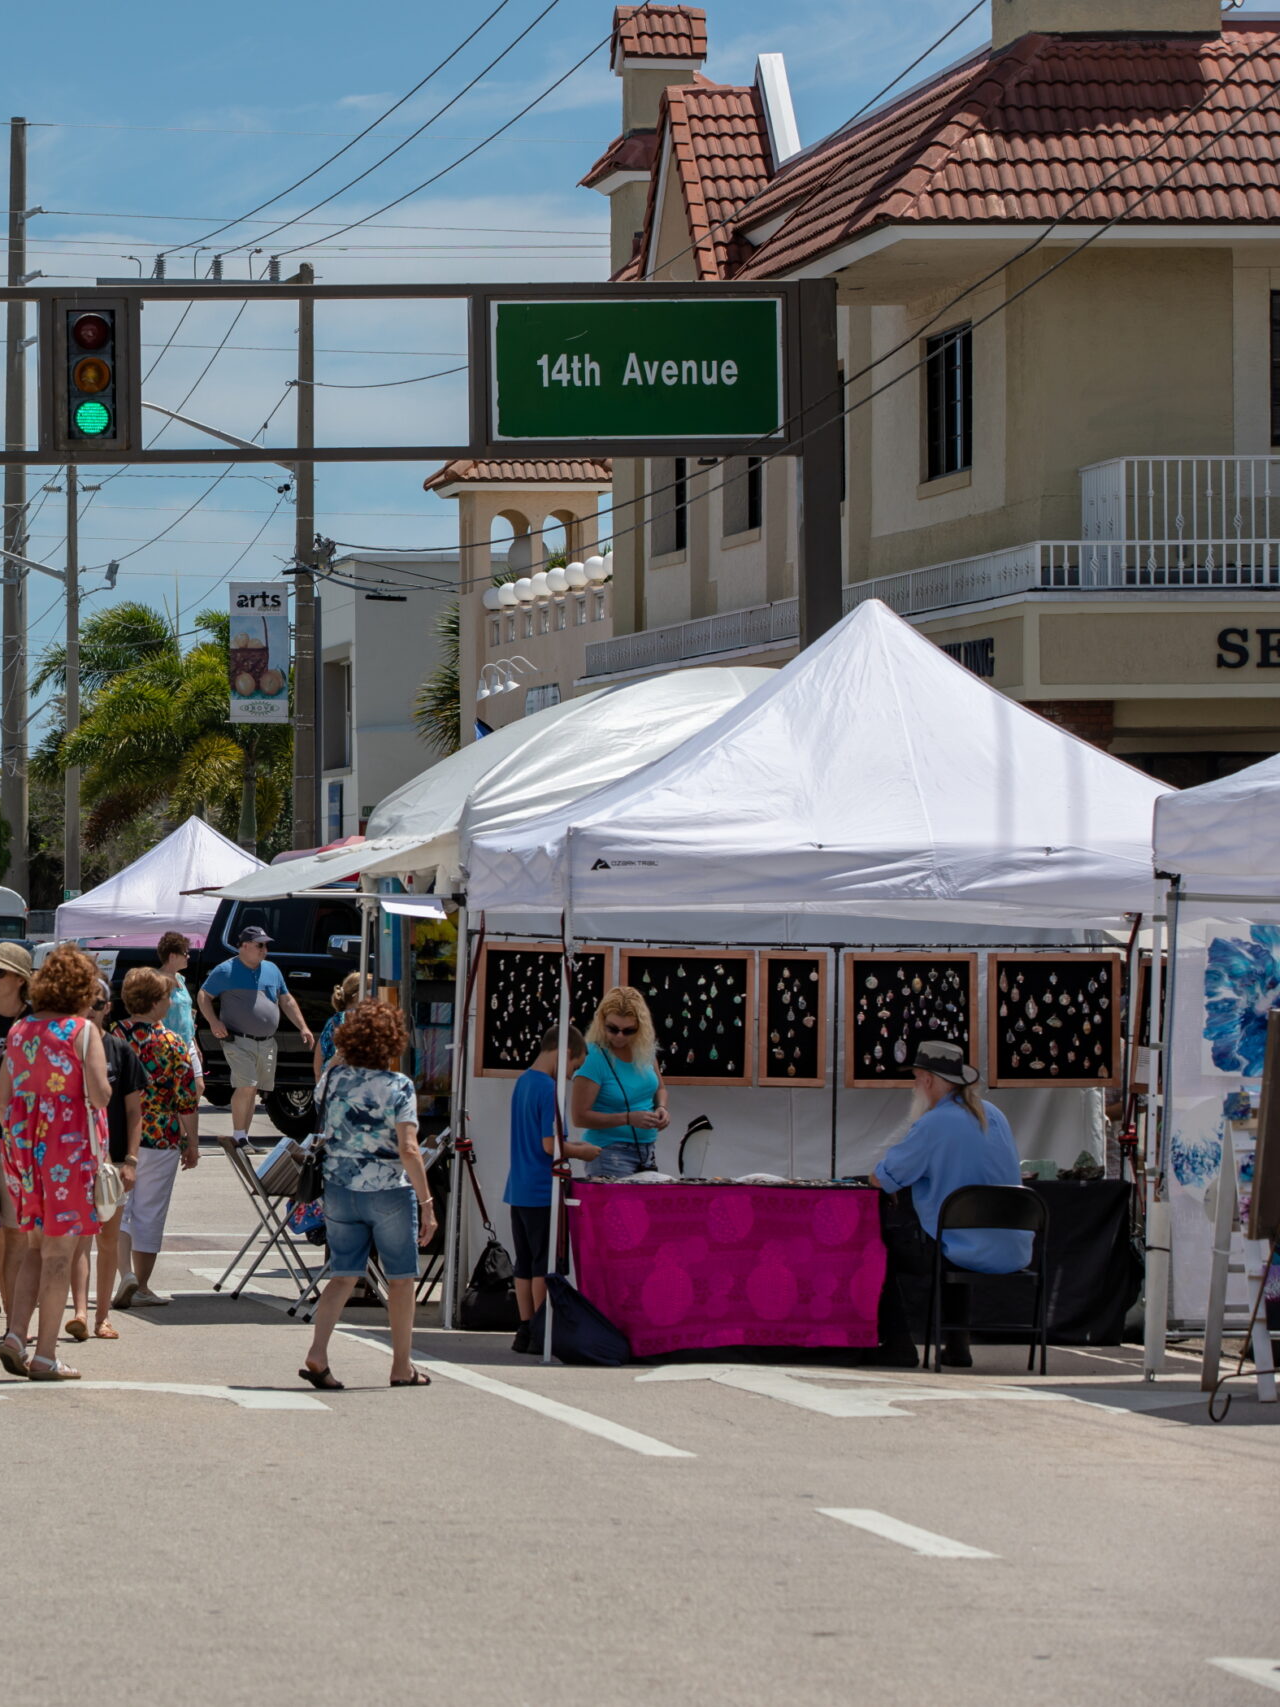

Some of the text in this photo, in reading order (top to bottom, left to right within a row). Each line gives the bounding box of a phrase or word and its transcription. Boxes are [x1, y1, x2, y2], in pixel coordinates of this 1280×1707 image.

[536, 352, 738, 387] 14th Avenue
[236, 591, 282, 608] arts
